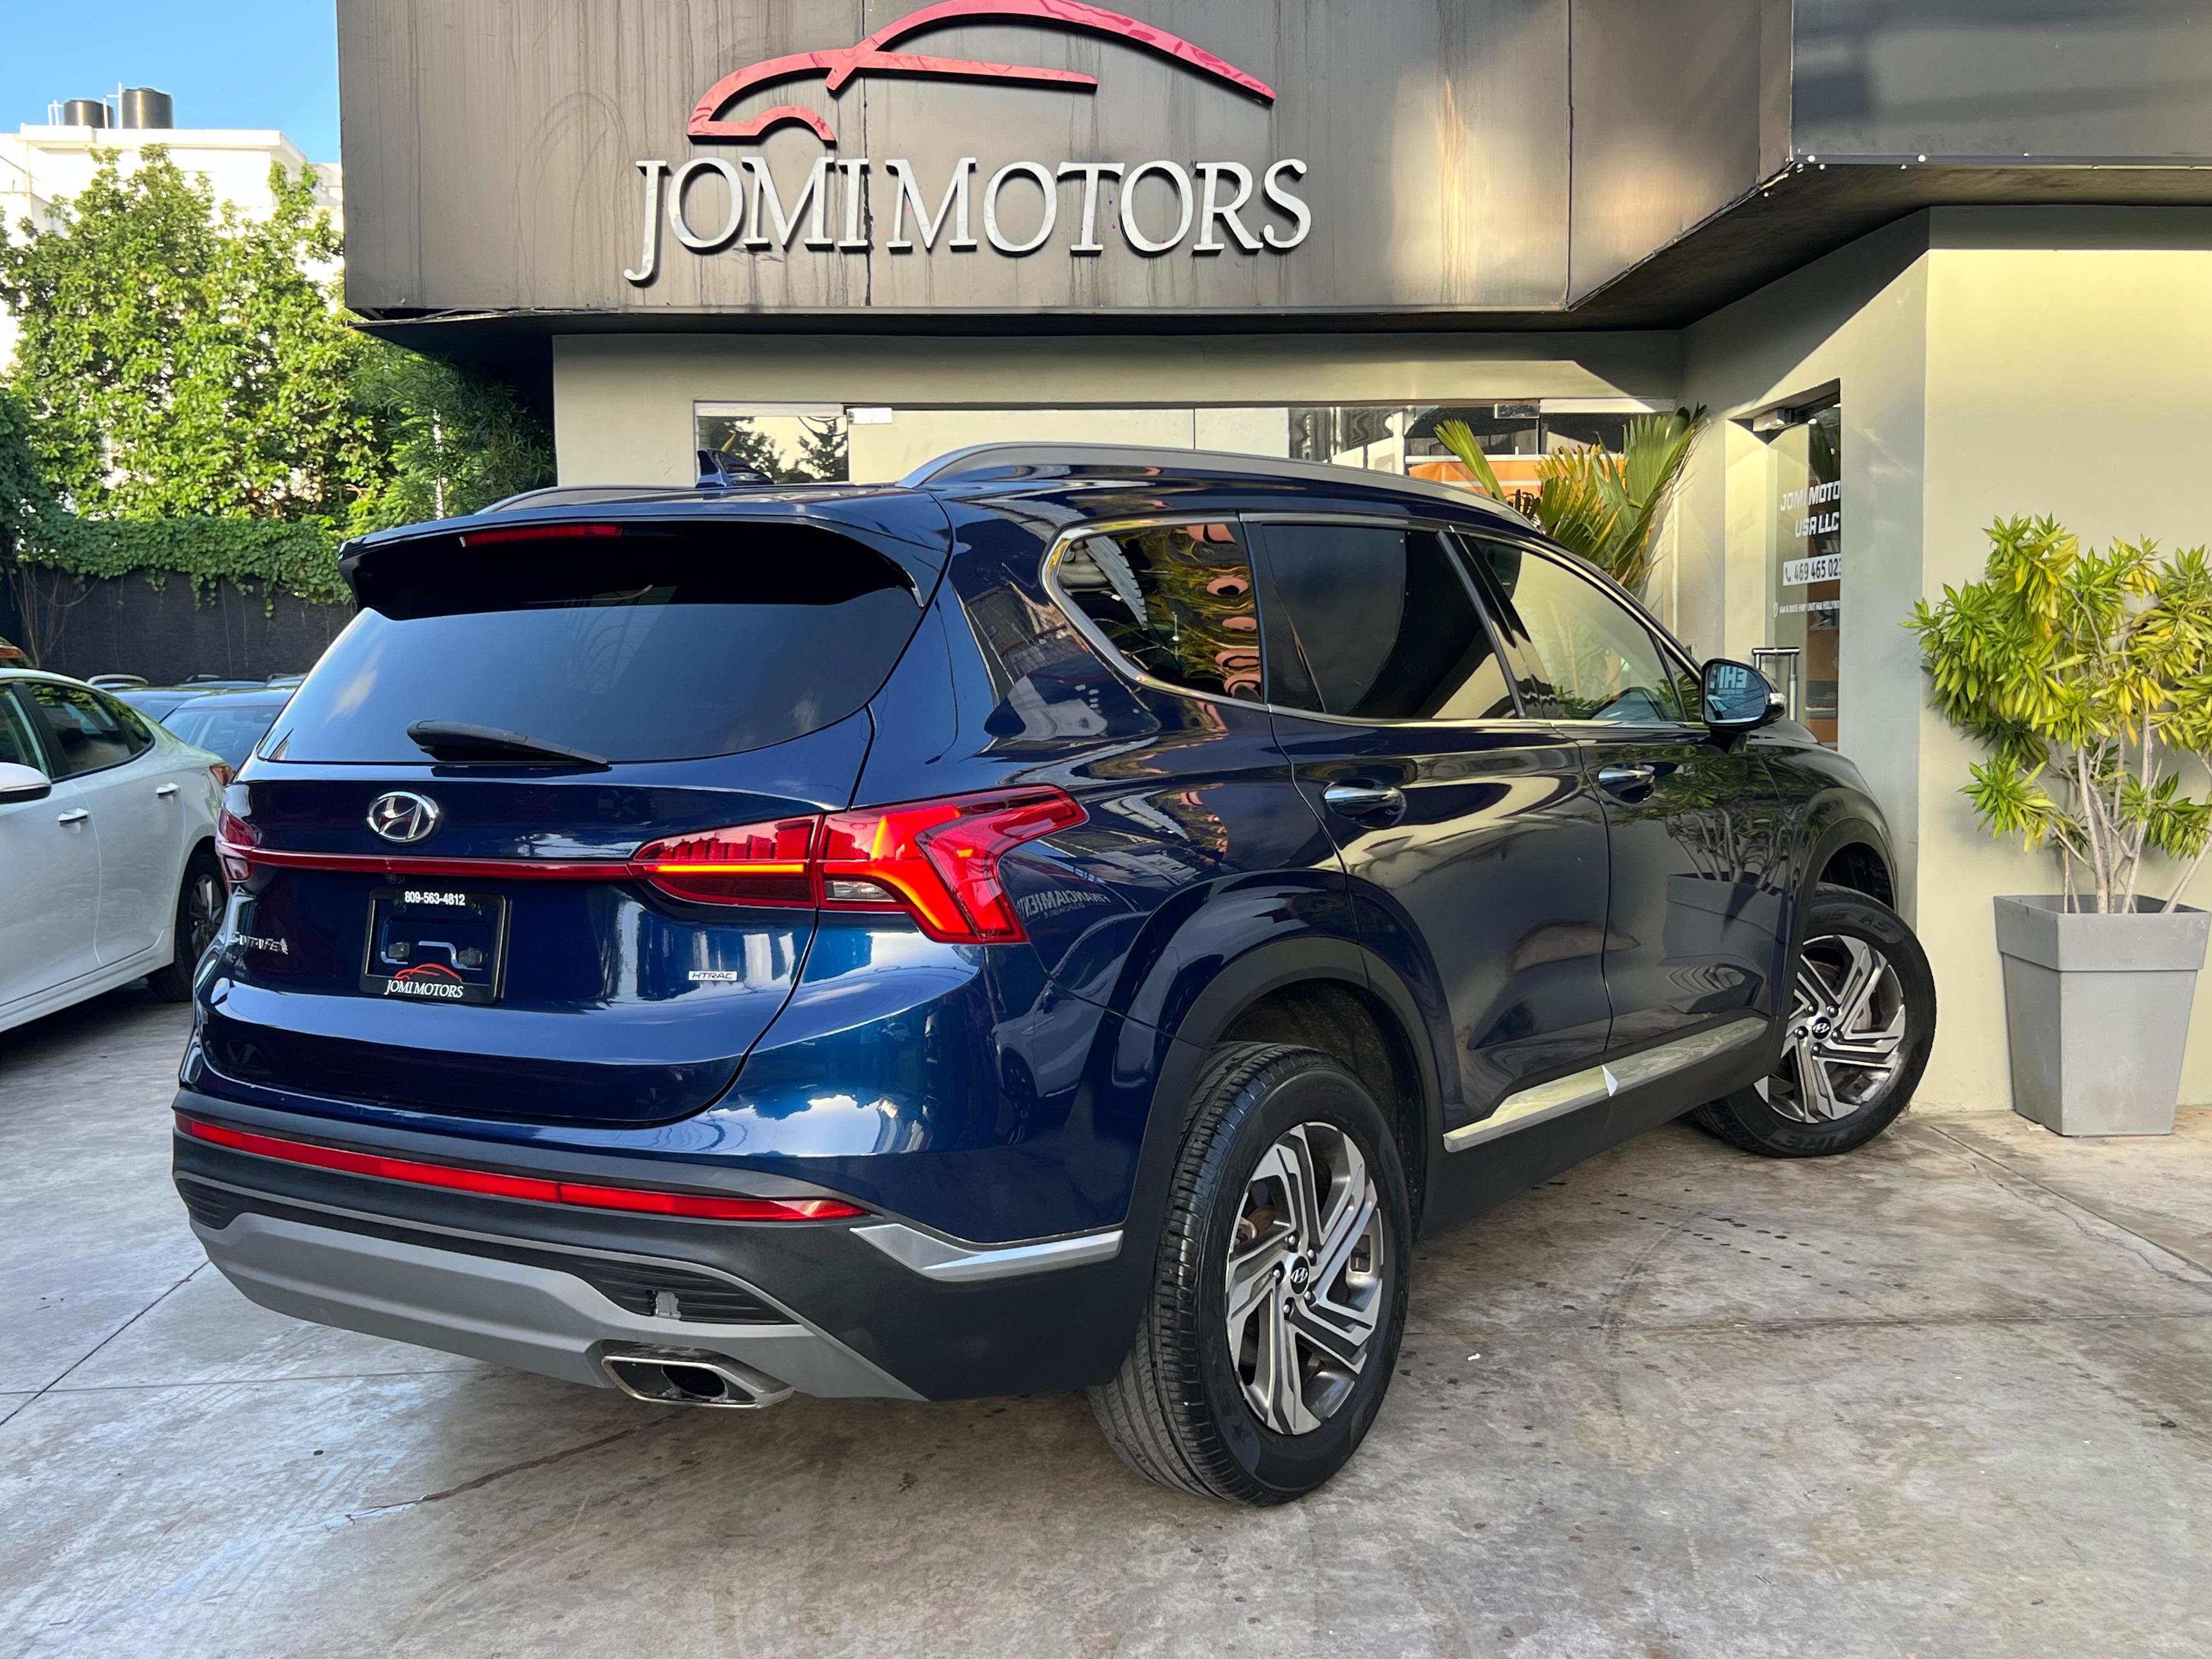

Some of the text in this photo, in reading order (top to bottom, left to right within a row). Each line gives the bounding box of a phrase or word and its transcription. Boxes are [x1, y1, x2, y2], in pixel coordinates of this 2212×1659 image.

[623, 156, 1312, 283] JOMI MOTORS
[1780, 487, 1808, 511] JOMI
[1795, 511, 1839, 538] USA LLC
[1794, 562, 1809, 582] 469
[1811, 560, 1826, 580] 465
[404, 891, 466, 906] 809-563-4812
[385, 979, 464, 998] JOMI MOTORS
